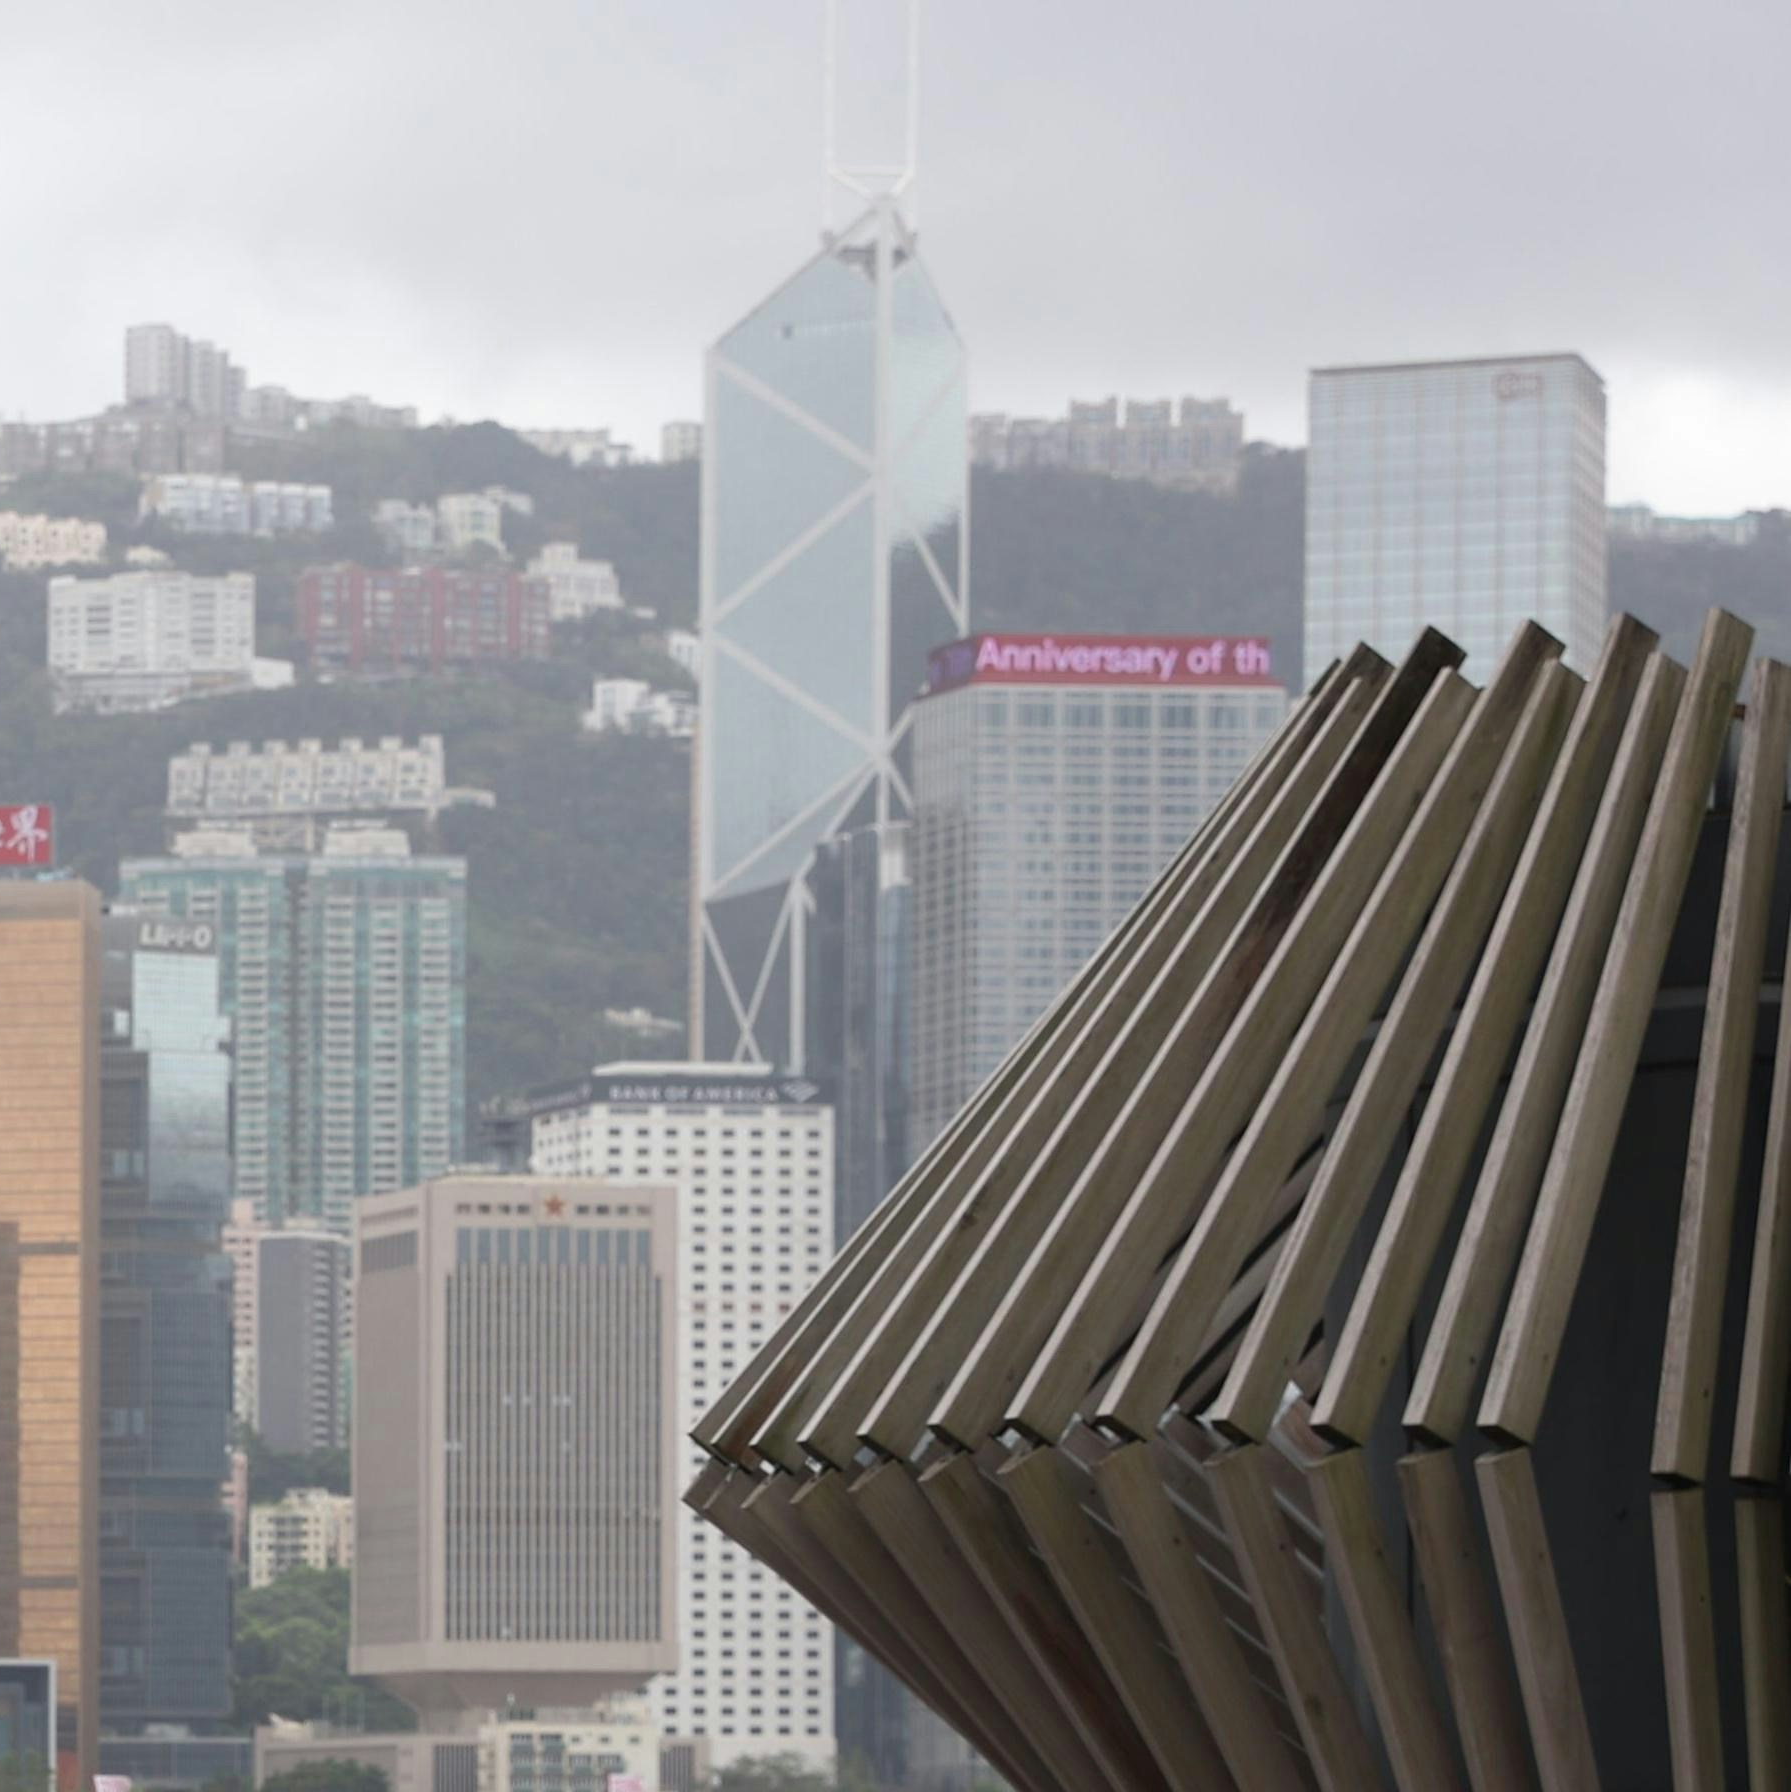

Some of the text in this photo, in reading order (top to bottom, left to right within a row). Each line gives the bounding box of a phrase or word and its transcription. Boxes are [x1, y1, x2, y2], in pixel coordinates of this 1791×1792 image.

[975, 637, 1270, 681] Anniversary of th
[609, 1084, 661, 1101] BANK
[692, 1084, 779, 1101] AMERICA
